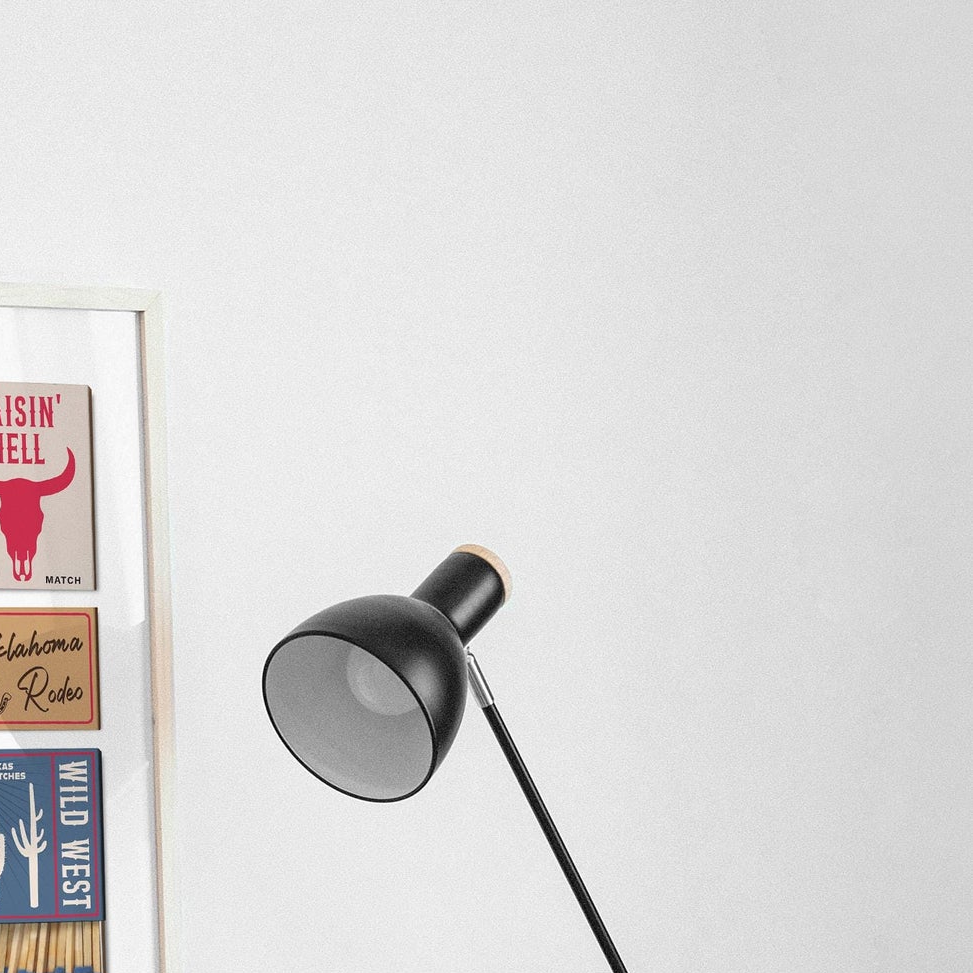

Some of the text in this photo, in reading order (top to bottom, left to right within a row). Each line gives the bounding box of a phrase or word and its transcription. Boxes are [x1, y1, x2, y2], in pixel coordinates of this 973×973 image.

[45, 575, 81, 585] MATCH
[17, 666, 83, 712] Rodeo
[58, 760, 91, 909] WILD WEST
